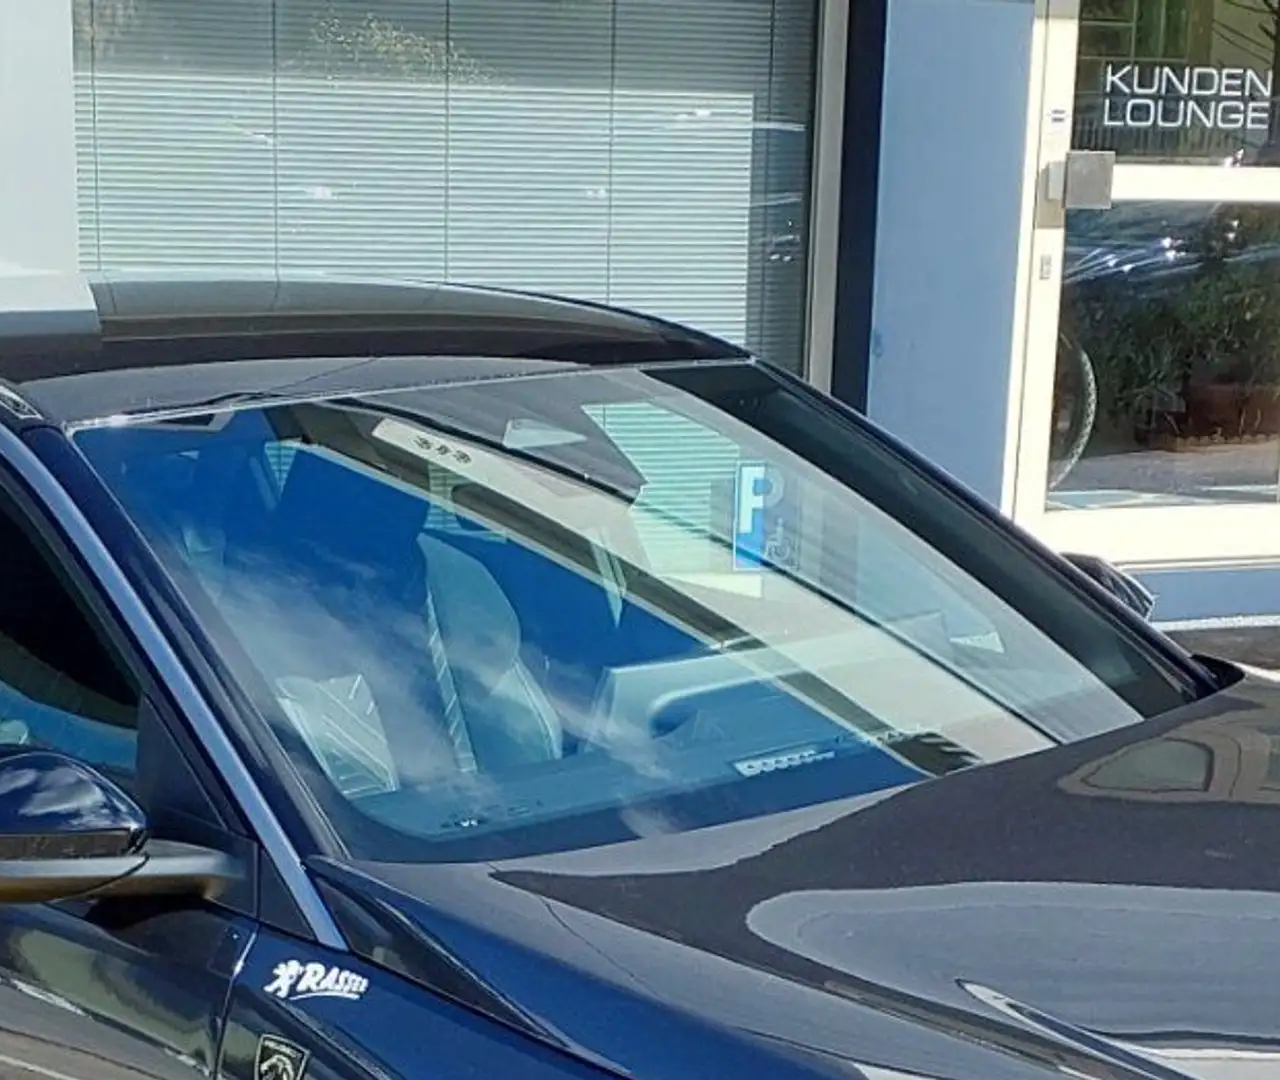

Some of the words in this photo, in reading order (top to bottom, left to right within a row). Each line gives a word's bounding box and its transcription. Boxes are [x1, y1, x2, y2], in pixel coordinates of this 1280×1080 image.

[1104, 64, 1272, 97] KUNDEN
[1102, 98, 1270, 129] LOUNGE
[738, 465, 785, 534] P
